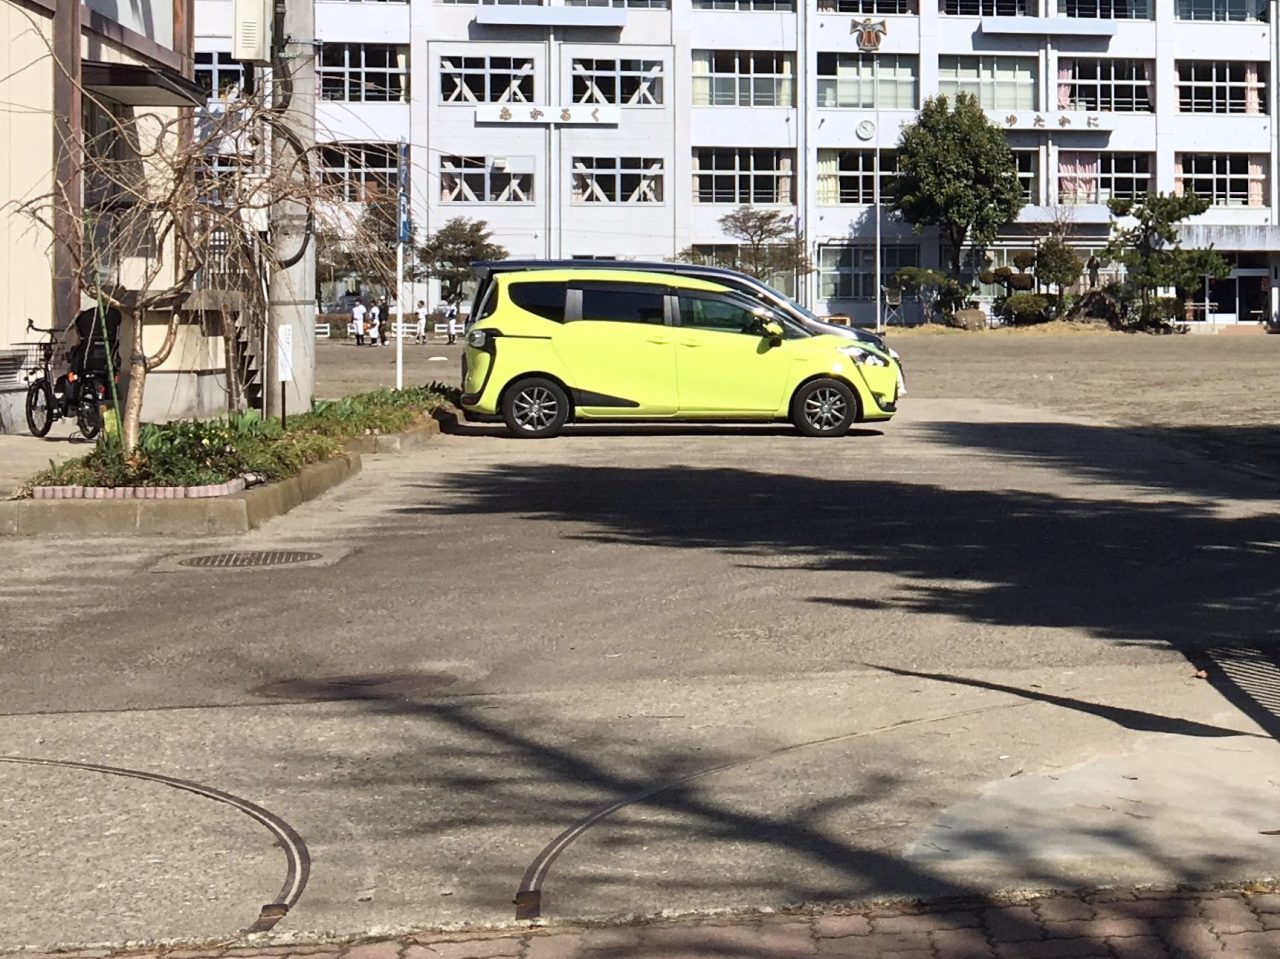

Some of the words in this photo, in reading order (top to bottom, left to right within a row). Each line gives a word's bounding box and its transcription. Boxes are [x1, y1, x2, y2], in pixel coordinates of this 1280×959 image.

[499, 106, 600, 122] あかるく
[1005, 114, 1100, 128] ゆたかに
